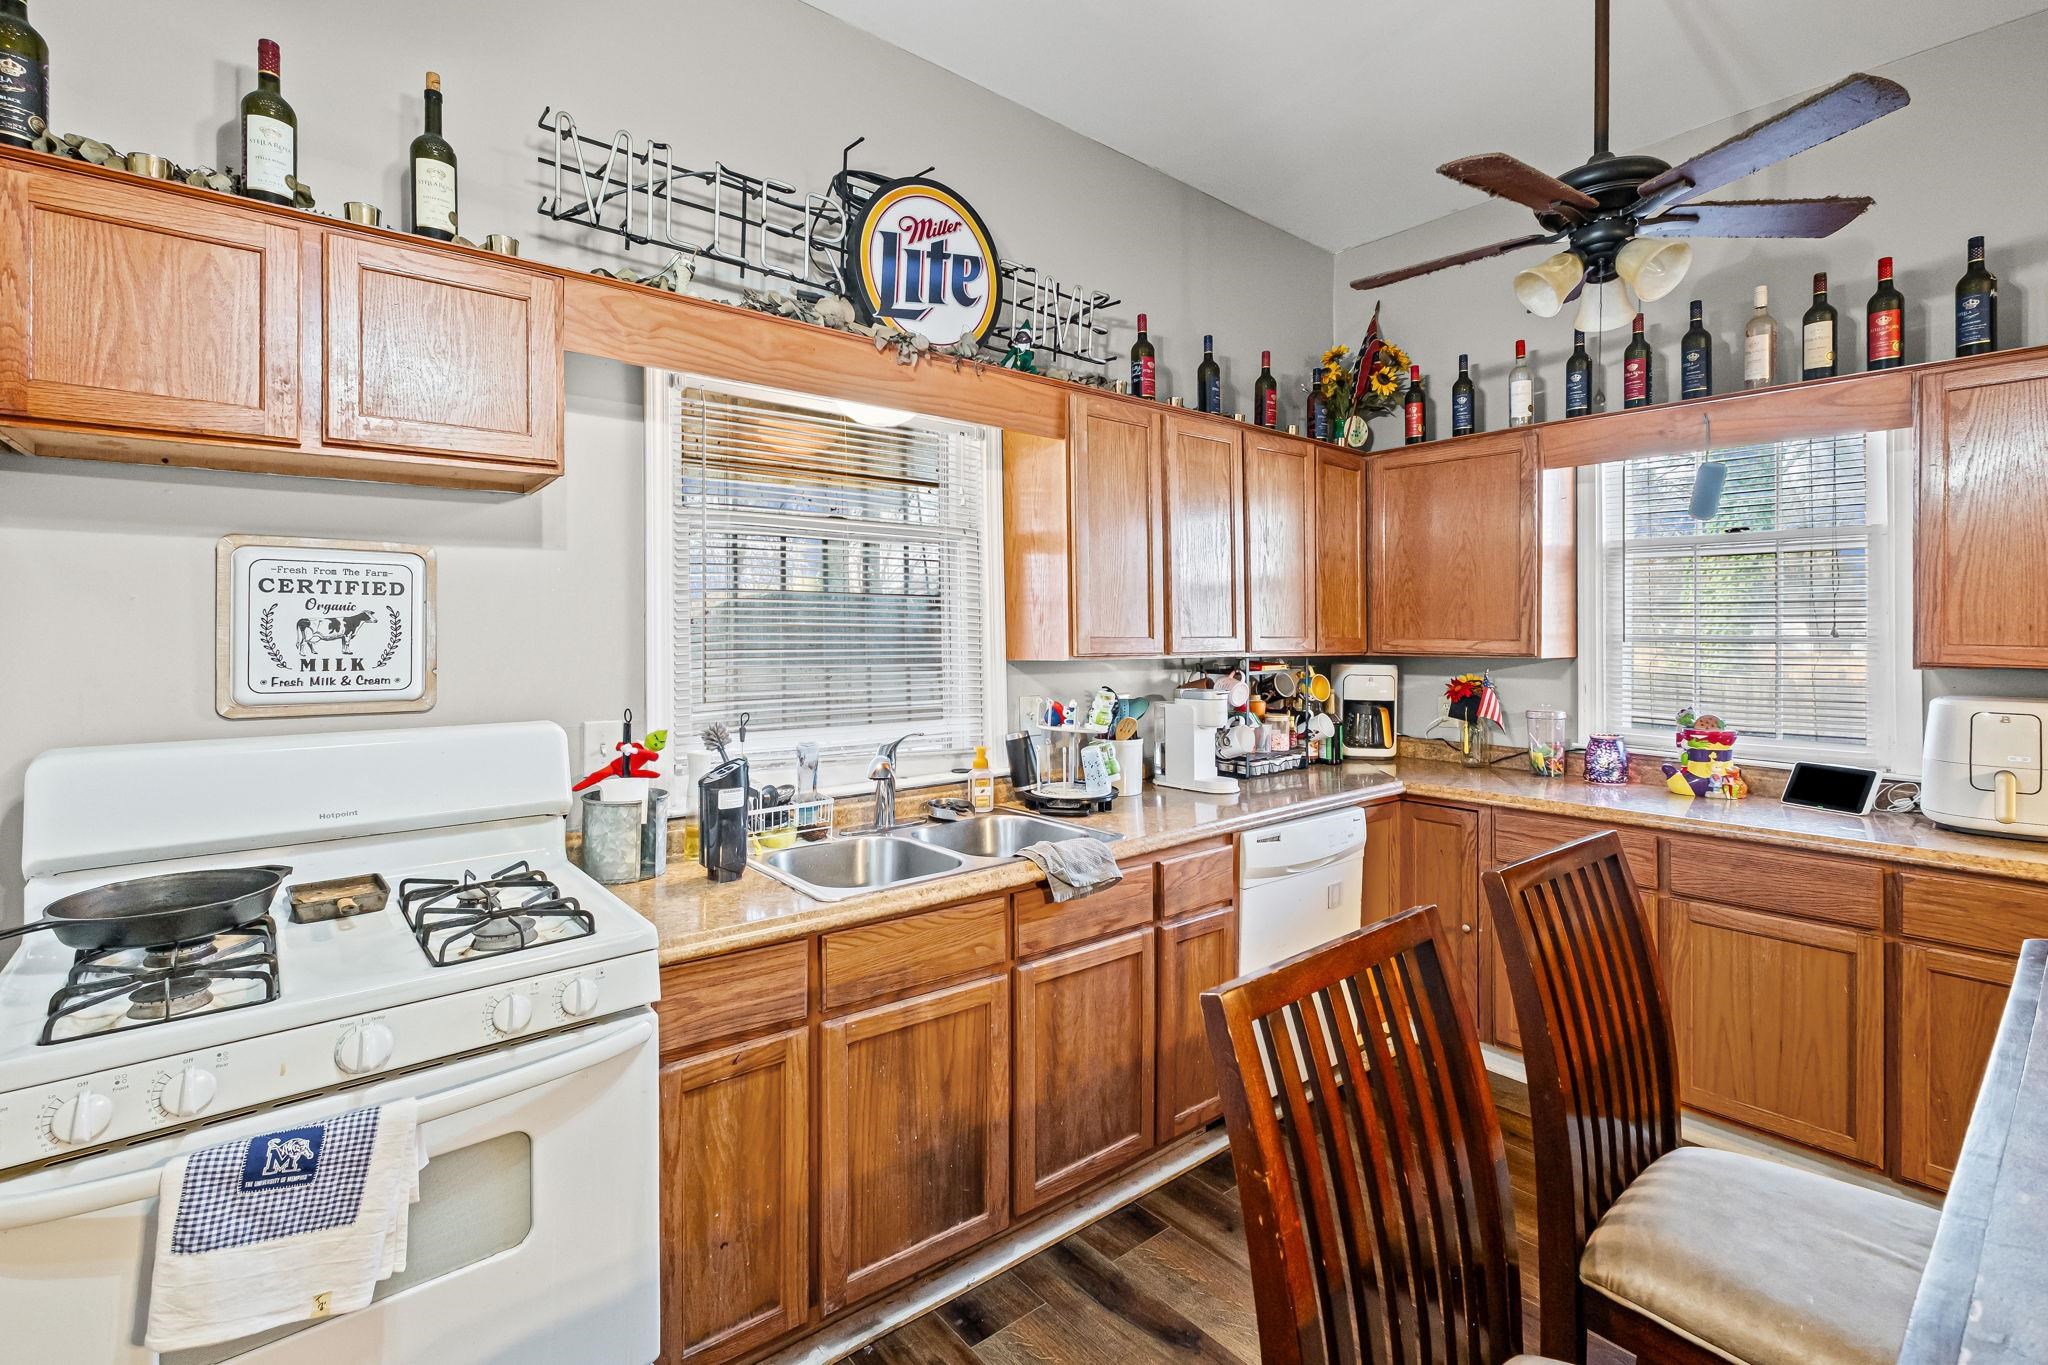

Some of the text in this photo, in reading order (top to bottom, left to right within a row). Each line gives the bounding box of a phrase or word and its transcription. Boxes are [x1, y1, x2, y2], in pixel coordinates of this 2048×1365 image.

[898, 215, 962, 244] Miller
[872, 230, 984, 321] Lite
[313, 567, 337, 576] From
[342, 568, 360, 577] The
[258, 577, 405, 596] CERTIFIED
[305, 597, 357, 615] Organic
[300, 657, 366, 673] MILK
[270, 676, 391, 688] Fresh Milk & Cream
[319, 810, 358, 820] Hotpoint
